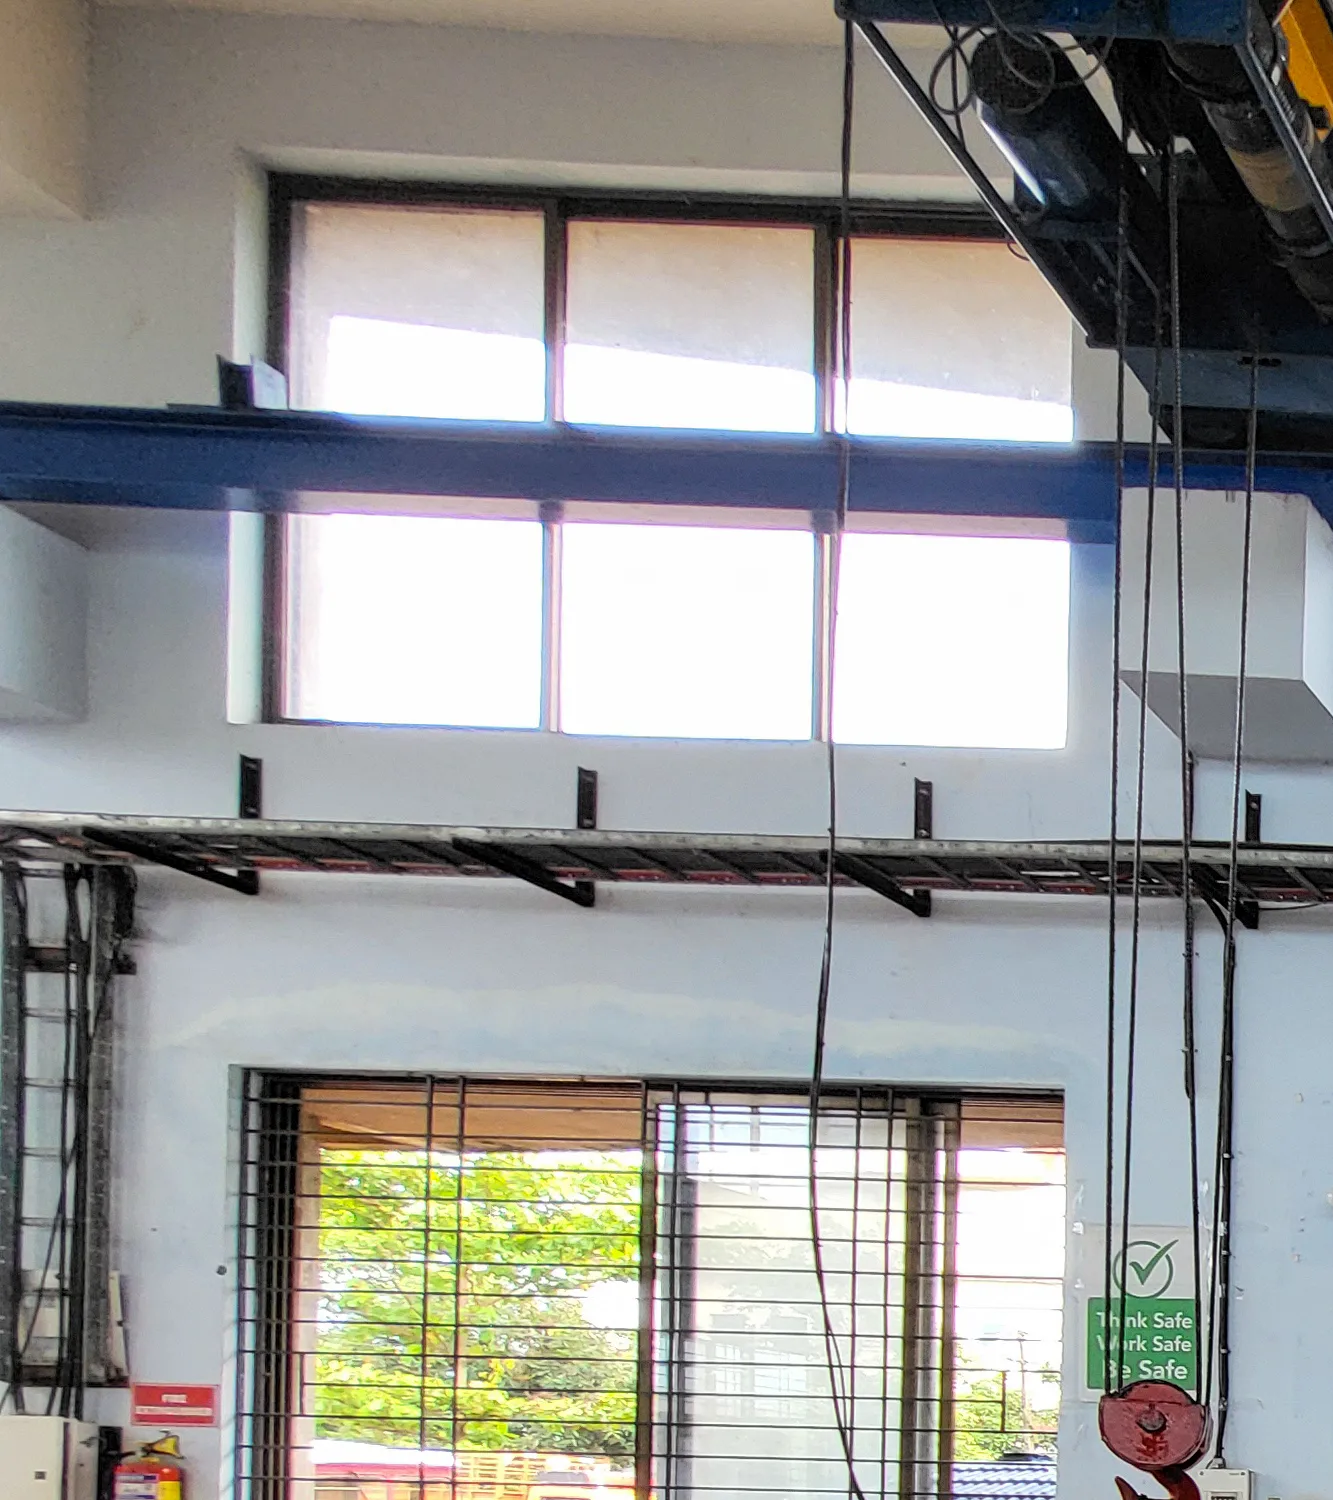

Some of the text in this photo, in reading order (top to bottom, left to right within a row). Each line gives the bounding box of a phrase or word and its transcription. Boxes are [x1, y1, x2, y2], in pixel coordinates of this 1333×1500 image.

[1095, 1311, 1193, 1329] Thnk Safe
[1152, 1334, 1192, 1352] Safe
[1138, 1359, 1188, 1380] Safe
